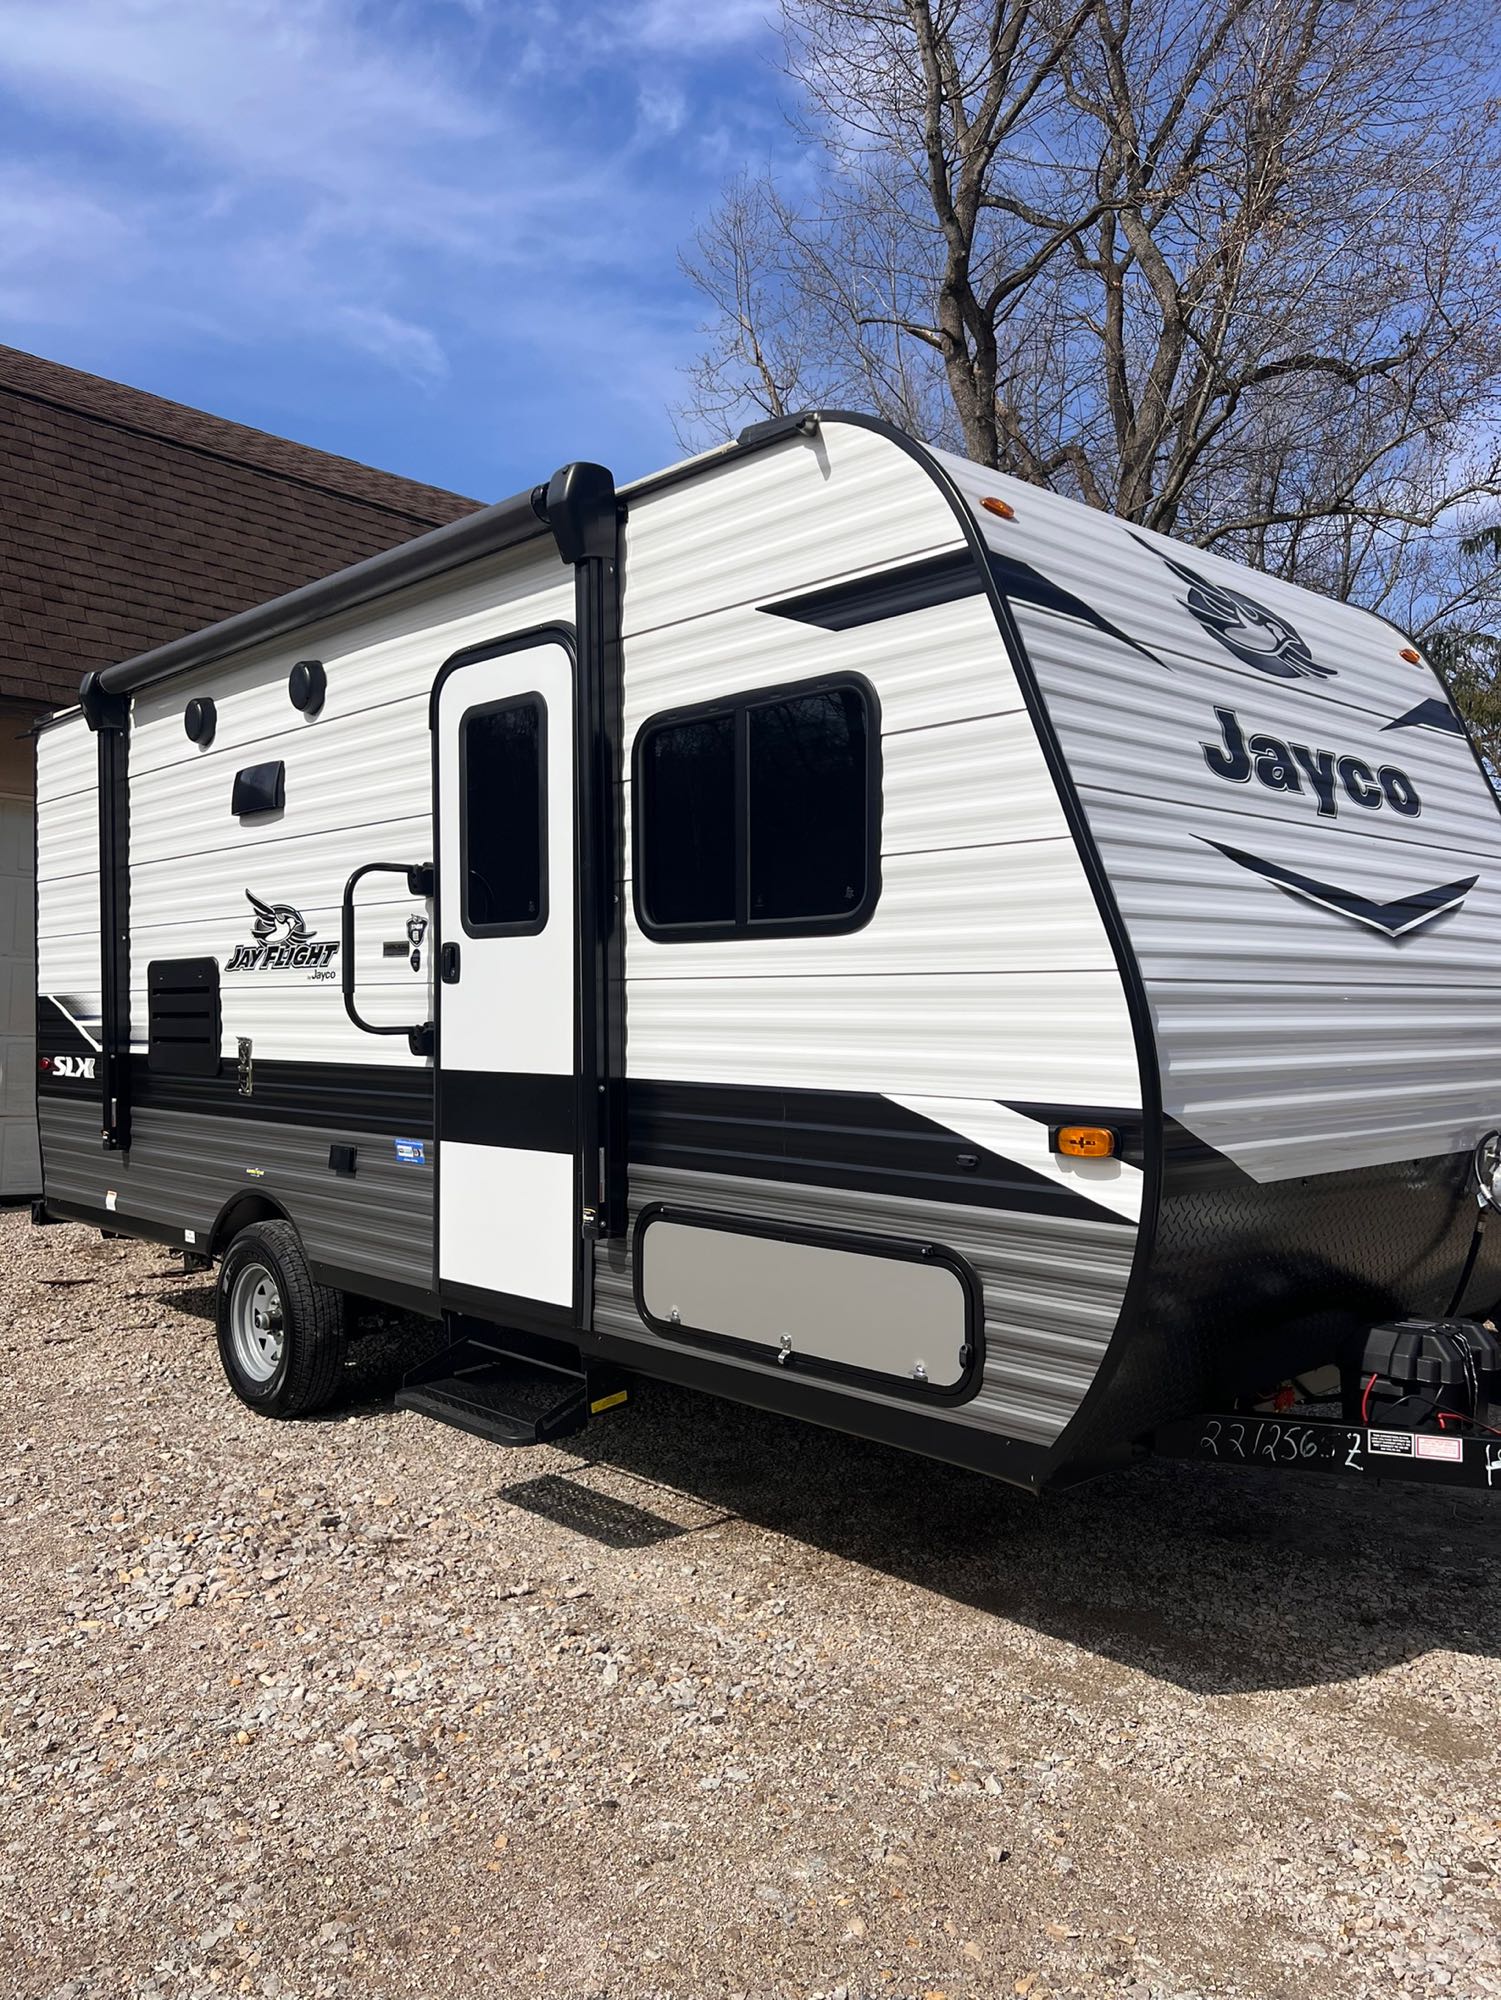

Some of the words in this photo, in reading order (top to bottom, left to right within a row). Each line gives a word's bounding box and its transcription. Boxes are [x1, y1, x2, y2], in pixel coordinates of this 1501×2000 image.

[1198, 705, 1421, 819] Jayco
[225, 944, 264, 972] JAY
[259, 941, 340, 970] FLIGHT
[311, 969, 337, 982] Jayco
[52, 1056, 96, 1079] SLX
